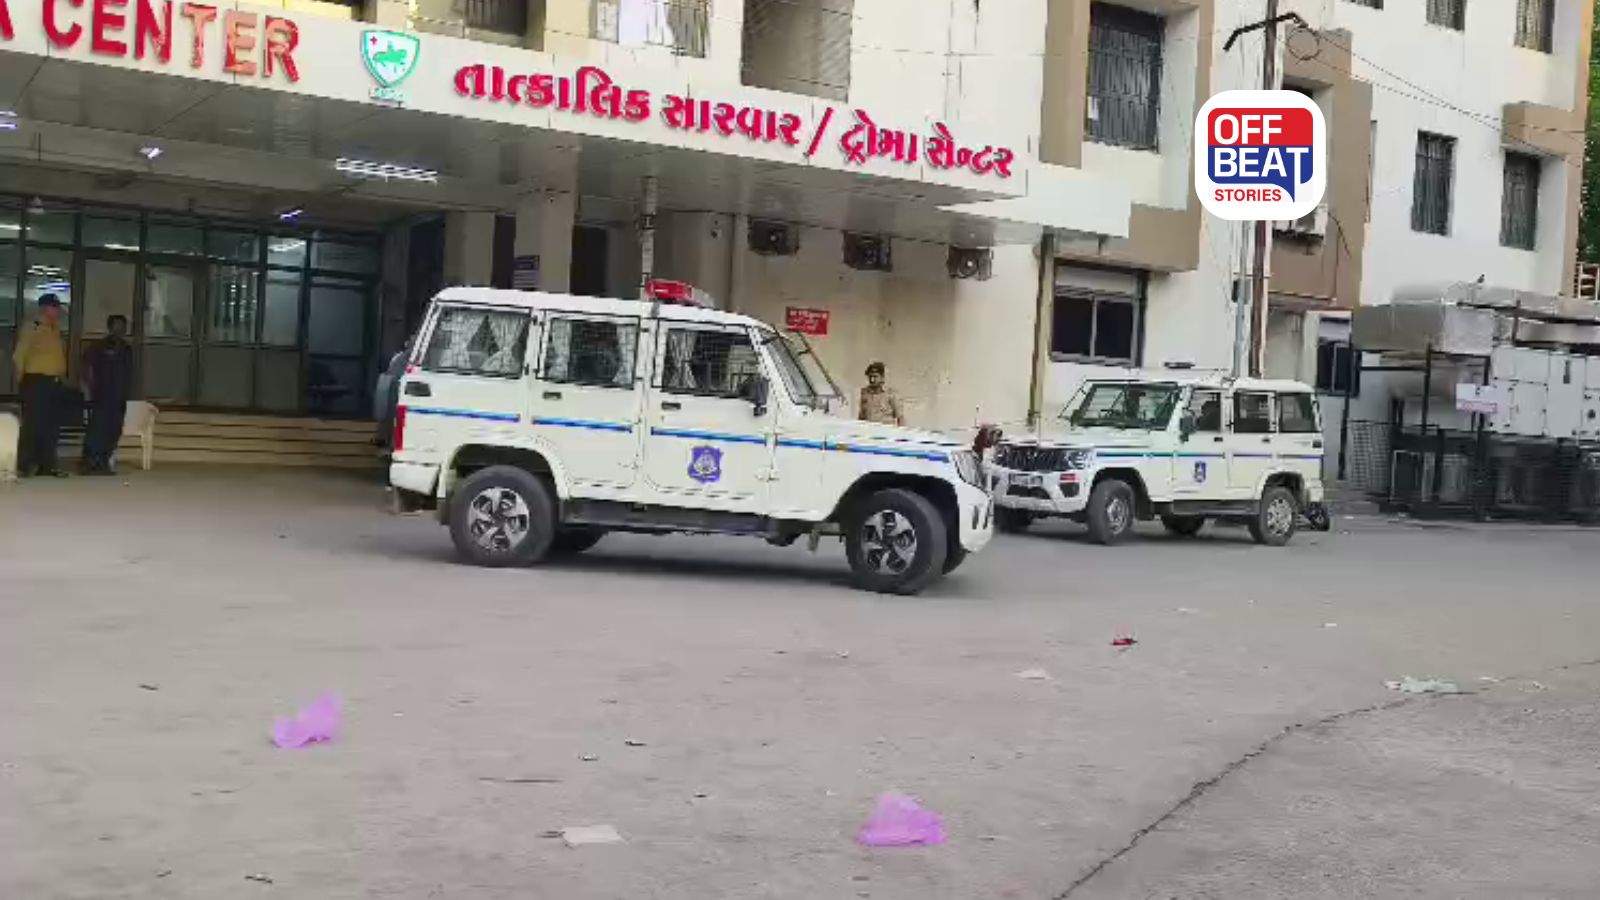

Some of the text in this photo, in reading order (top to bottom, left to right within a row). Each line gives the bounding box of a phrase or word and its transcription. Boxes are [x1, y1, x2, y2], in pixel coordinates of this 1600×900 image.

[42, 0, 300, 82] CENTER
[453, 63, 651, 122] તાત્કાલિક
[661, 94, 802, 146] સારવાર
[806, 106, 834, 157] /
[926, 121, 1014, 178] સેન્ટર
